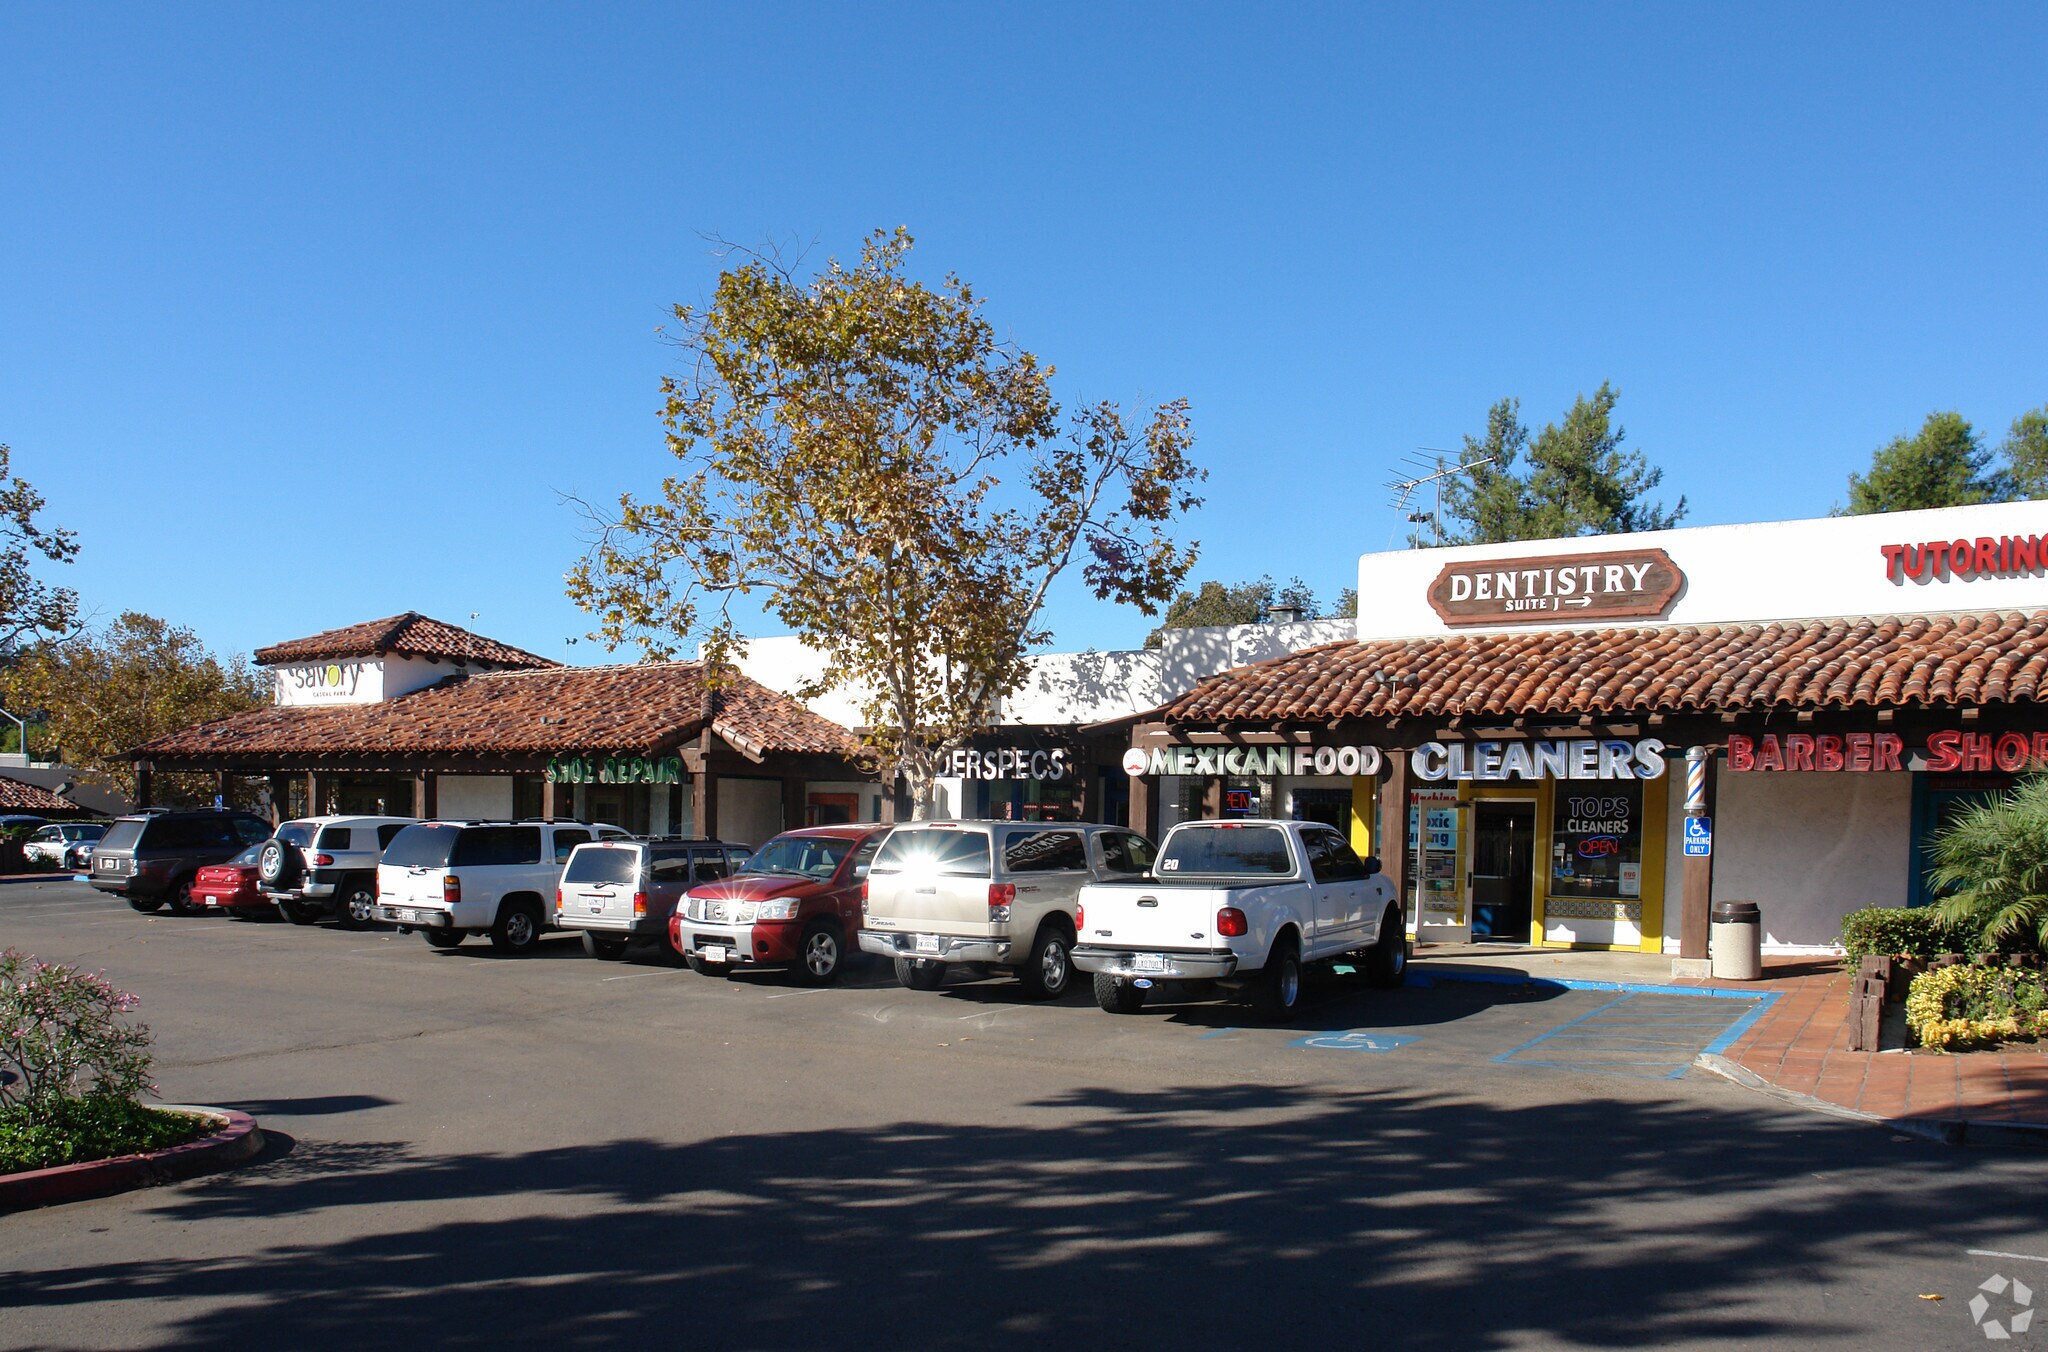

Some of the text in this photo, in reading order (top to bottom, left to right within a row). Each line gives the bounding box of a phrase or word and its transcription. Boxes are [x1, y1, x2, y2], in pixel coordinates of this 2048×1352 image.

[1450, 562, 1653, 602] DENTISTRY
[1505, 597, 1560, 612] SUITE J
[295, 663, 360, 696] savory
[1148, 745, 1383, 776] MEXICAN FOOD
[1411, 738, 1666, 781] CLEANERS
[1727, 733, 1904, 772] BARBER
[546, 757, 680, 784] SHOE REPAIR
[1567, 819, 1629, 833] CLEANERS
[1578, 840, 1618, 853] OPEN
[1686, 836, 1709, 845] PARKING
[1689, 845, 1705, 854] ONLY
[1163, 859, 1179, 870] 20
